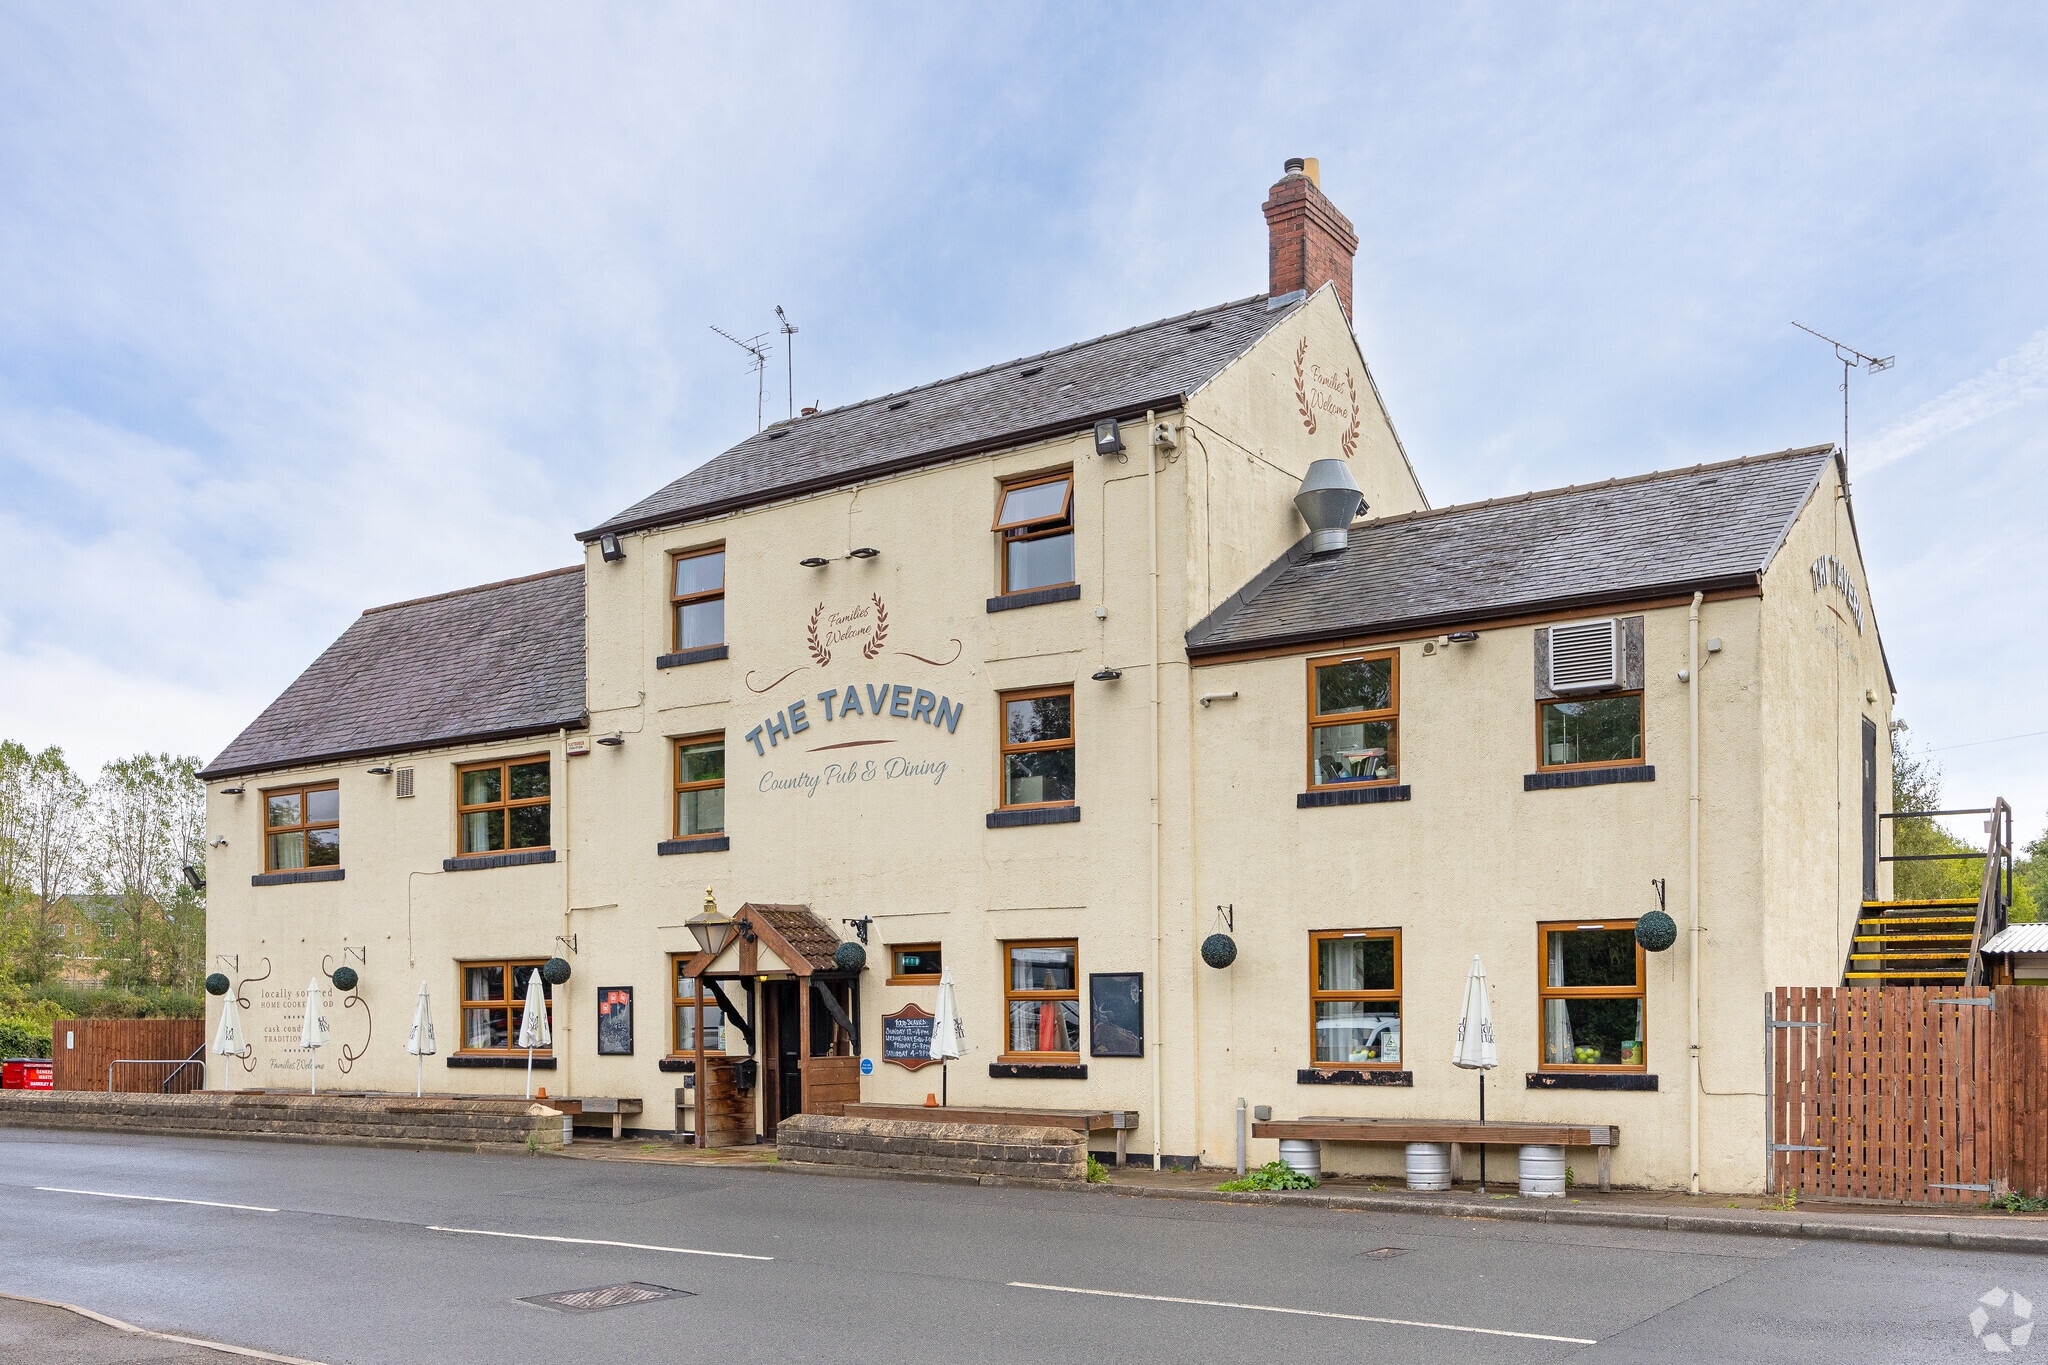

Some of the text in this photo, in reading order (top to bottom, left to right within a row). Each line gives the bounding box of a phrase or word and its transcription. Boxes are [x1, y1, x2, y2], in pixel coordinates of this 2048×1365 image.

[1310, 364, 1345, 394] Families
[1310, 388, 1348, 419] Welcome
[1829, 554, 1865, 638] TAVERN
[828, 605, 870, 627] Families
[826, 625, 872, 647] Welcome
[745, 683, 964, 756] THE TAVERN
[758, 756, 949, 798] Country Pub & Dining
[261, 988, 333, 999] locally soed
[260, 1001, 280, 1009] HOME
[282, 1001, 307, 1009] COOKE
[264, 1025, 281, 1033] cask
[885, 1027, 906, 1035] SUNDAY
[893, 1041, 911, 1049] FRIDAY
[269, 1058, 325, 1070] Families Welcme
